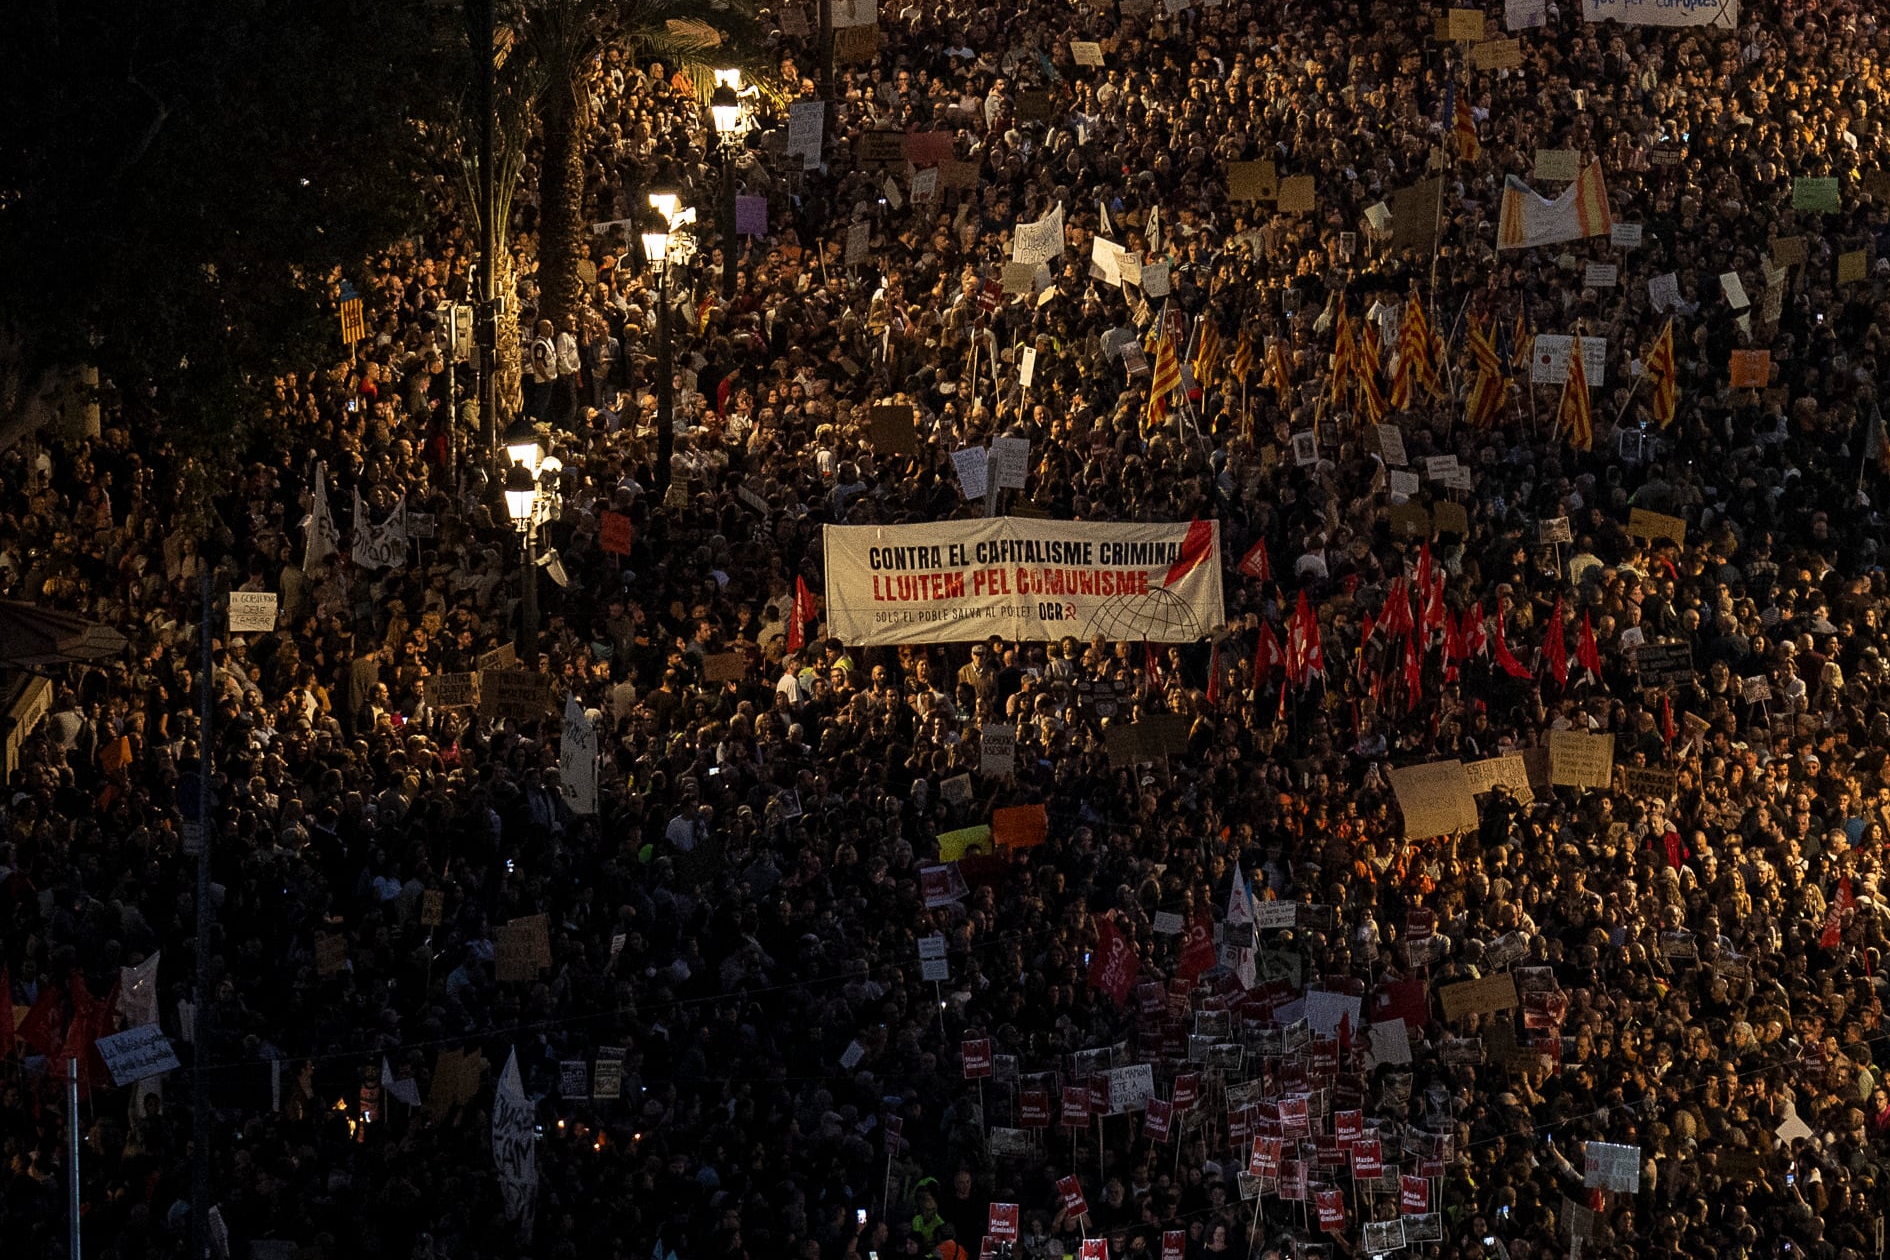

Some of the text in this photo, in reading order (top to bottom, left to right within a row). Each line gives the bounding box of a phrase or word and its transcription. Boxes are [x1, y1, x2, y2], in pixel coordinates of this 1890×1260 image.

[869, 545, 942, 570] CONTRA
[949, 544, 970, 566] EL
[976, 539, 1092, 565] CAPITALISME
[873, 569, 1149, 601] LLUITEM PEL COMUNISME
[243, 605, 267, 614] DEBE
[876, 610, 900, 623] SOLS
[903, 609, 915, 623] EL
[918, 608, 949, 622] POBLE
[952, 607, 982, 620] SALVA
[985, 606, 997, 618] AL
[1039, 603, 1064, 621] OCR
[1628, 770, 1673, 785] CARLOS
[990, 1219, 1010, 1227] Mazón
